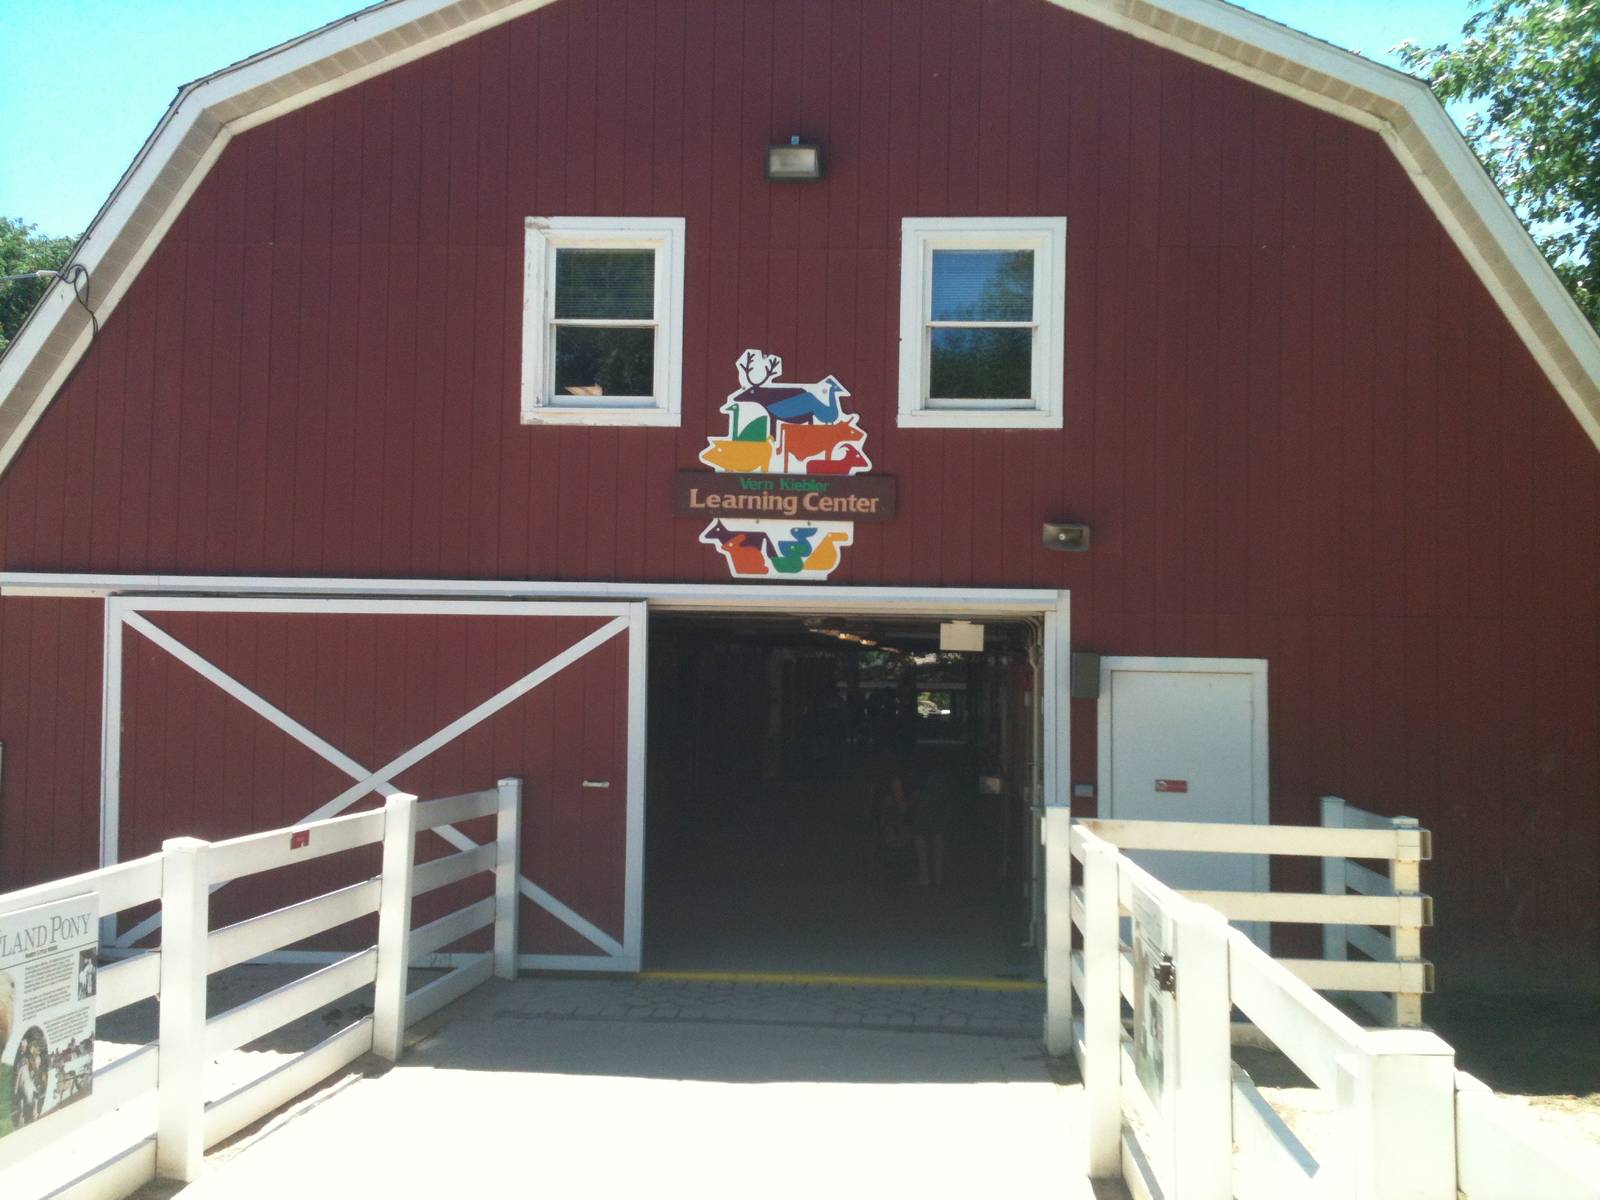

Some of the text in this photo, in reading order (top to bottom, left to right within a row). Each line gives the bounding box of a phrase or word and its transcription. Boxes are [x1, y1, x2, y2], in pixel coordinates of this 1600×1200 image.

[741, 478, 774, 490] Vern
[690, 489, 880, 516] Learning Center
[50, 912, 91, 944] PONY
